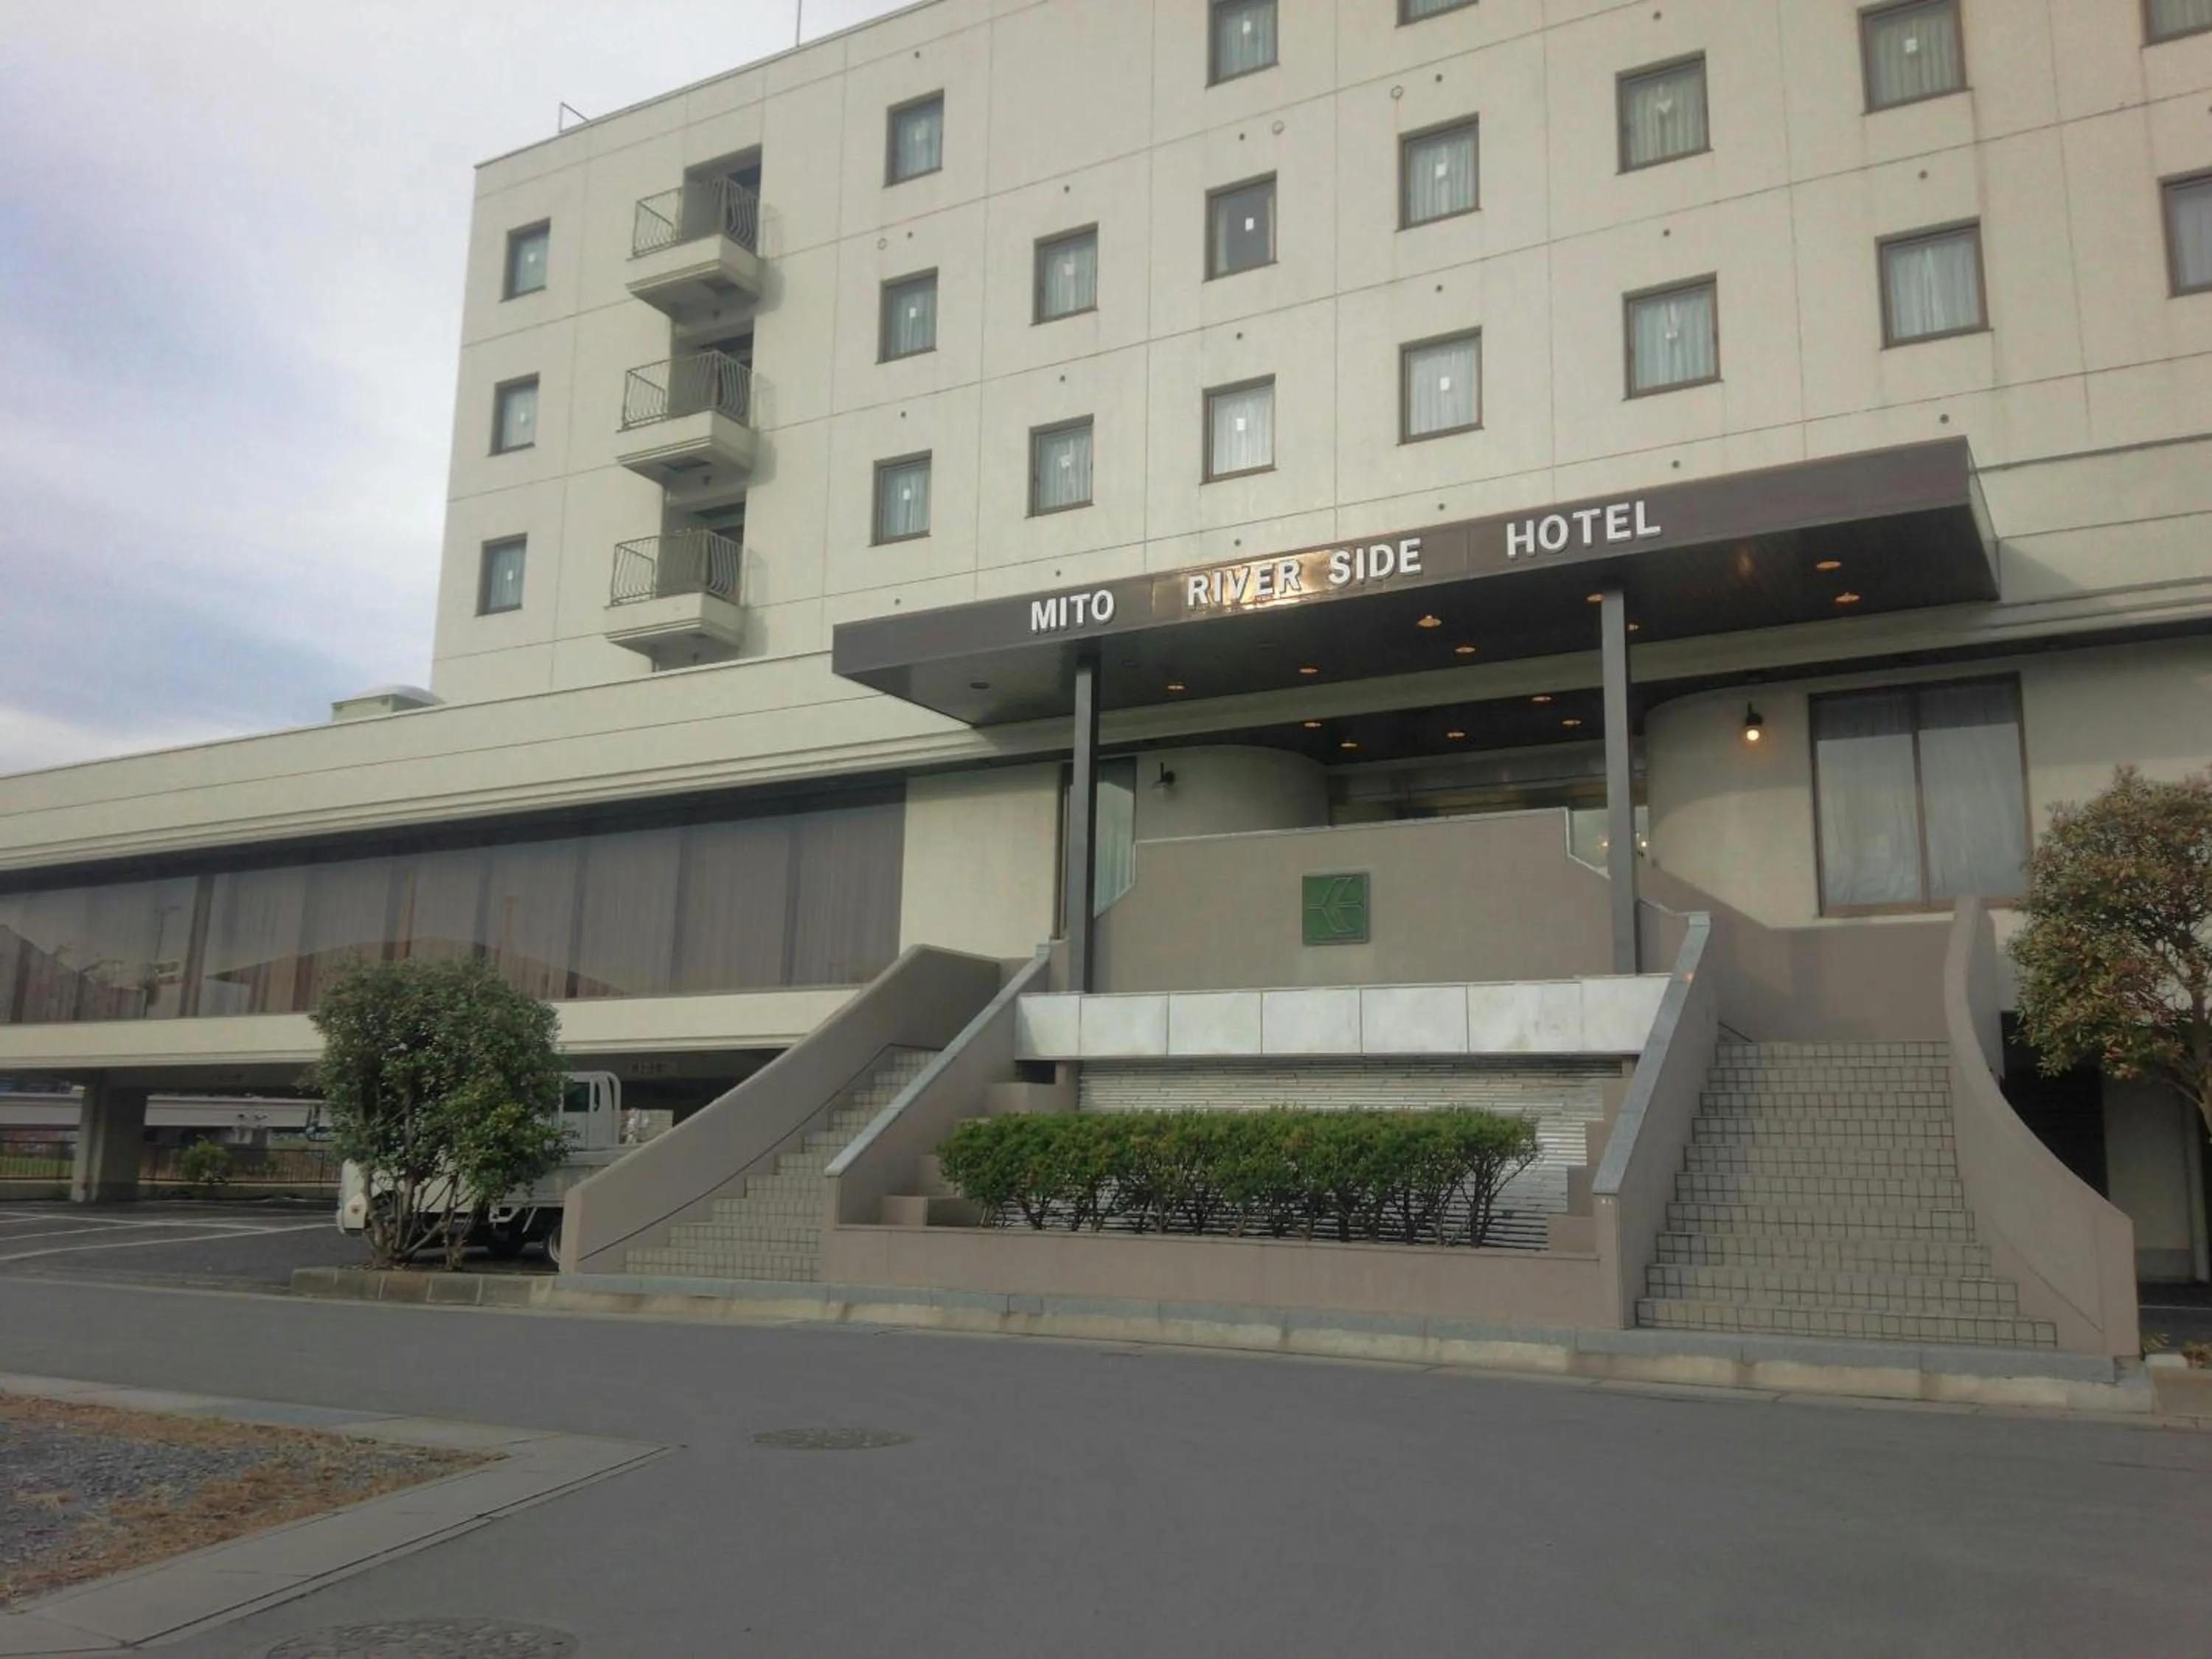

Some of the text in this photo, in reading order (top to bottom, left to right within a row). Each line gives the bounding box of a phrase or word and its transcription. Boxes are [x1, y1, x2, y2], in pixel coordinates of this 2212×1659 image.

[1030, 500, 1662, 634] MITO RIVER SIDE HOTEL
